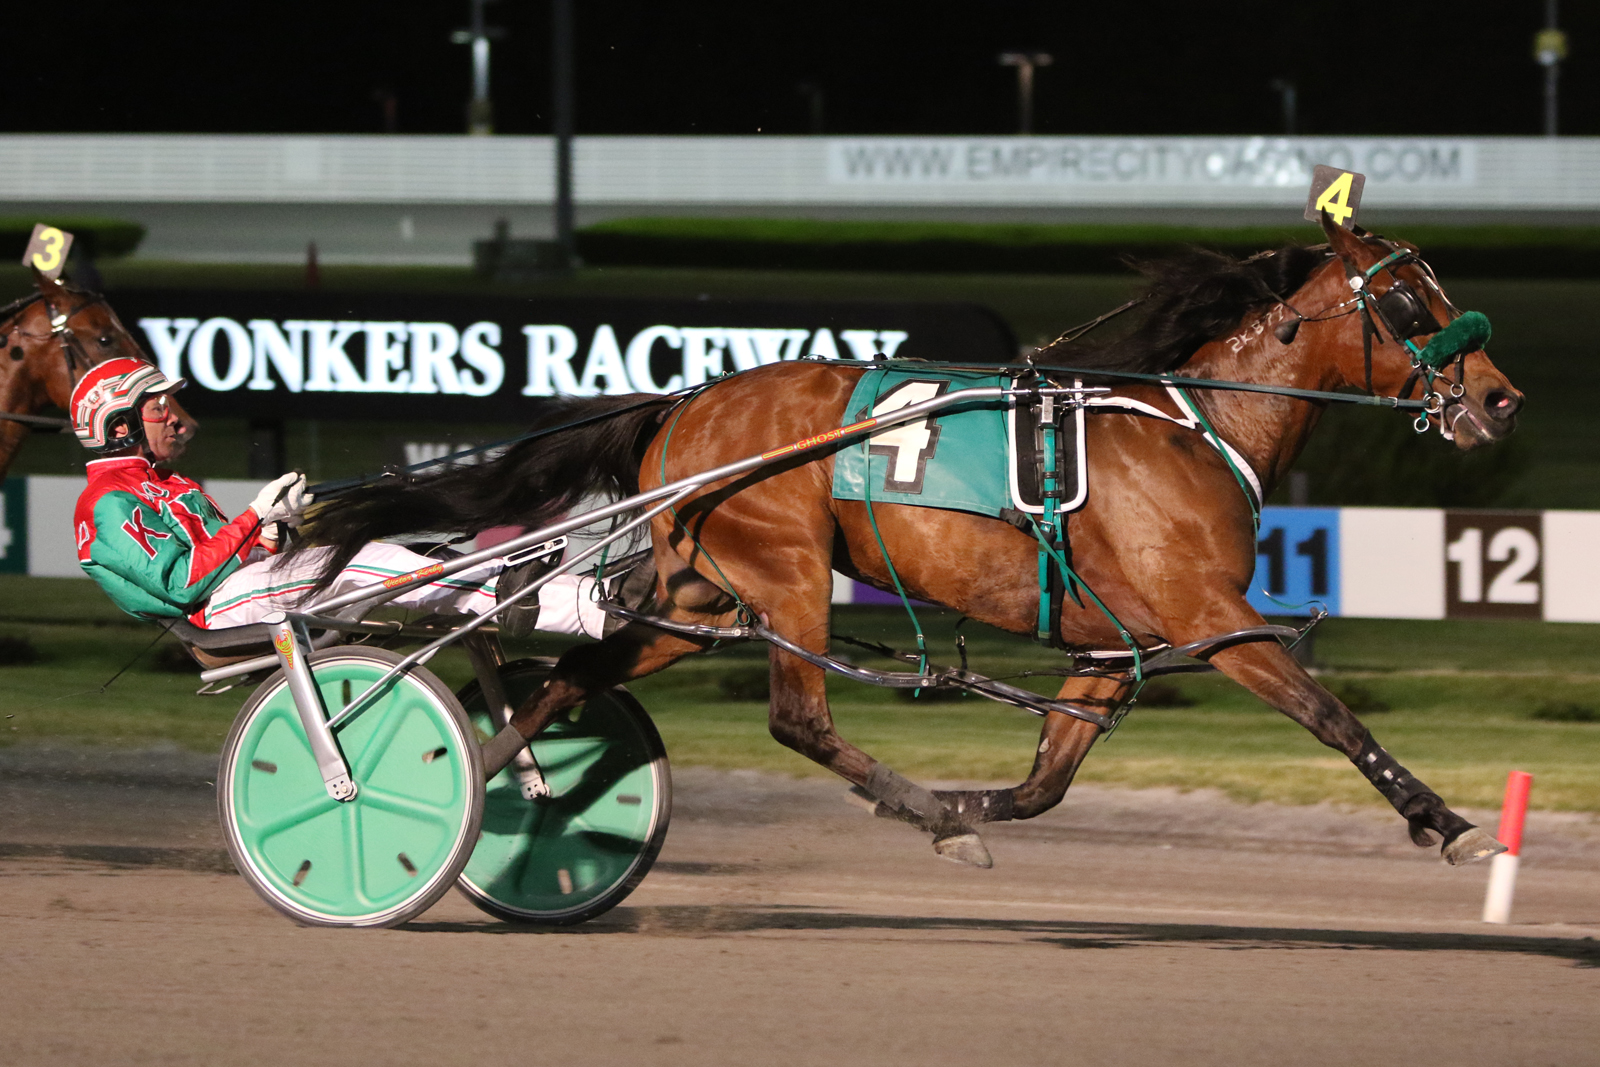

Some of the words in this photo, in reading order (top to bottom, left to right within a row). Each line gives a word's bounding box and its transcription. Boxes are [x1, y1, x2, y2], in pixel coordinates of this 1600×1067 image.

[1316, 172, 1354, 226] 4
[33, 227, 64, 271] 3
[137, 316, 505, 397] YONKERS
[796, 428, 843, 450] GHOST
[855, 379, 940, 491] 4
[120, 506, 172, 561] K
[1256, 528, 1328, 596] 11
[1448, 526, 1540, 605] 12
